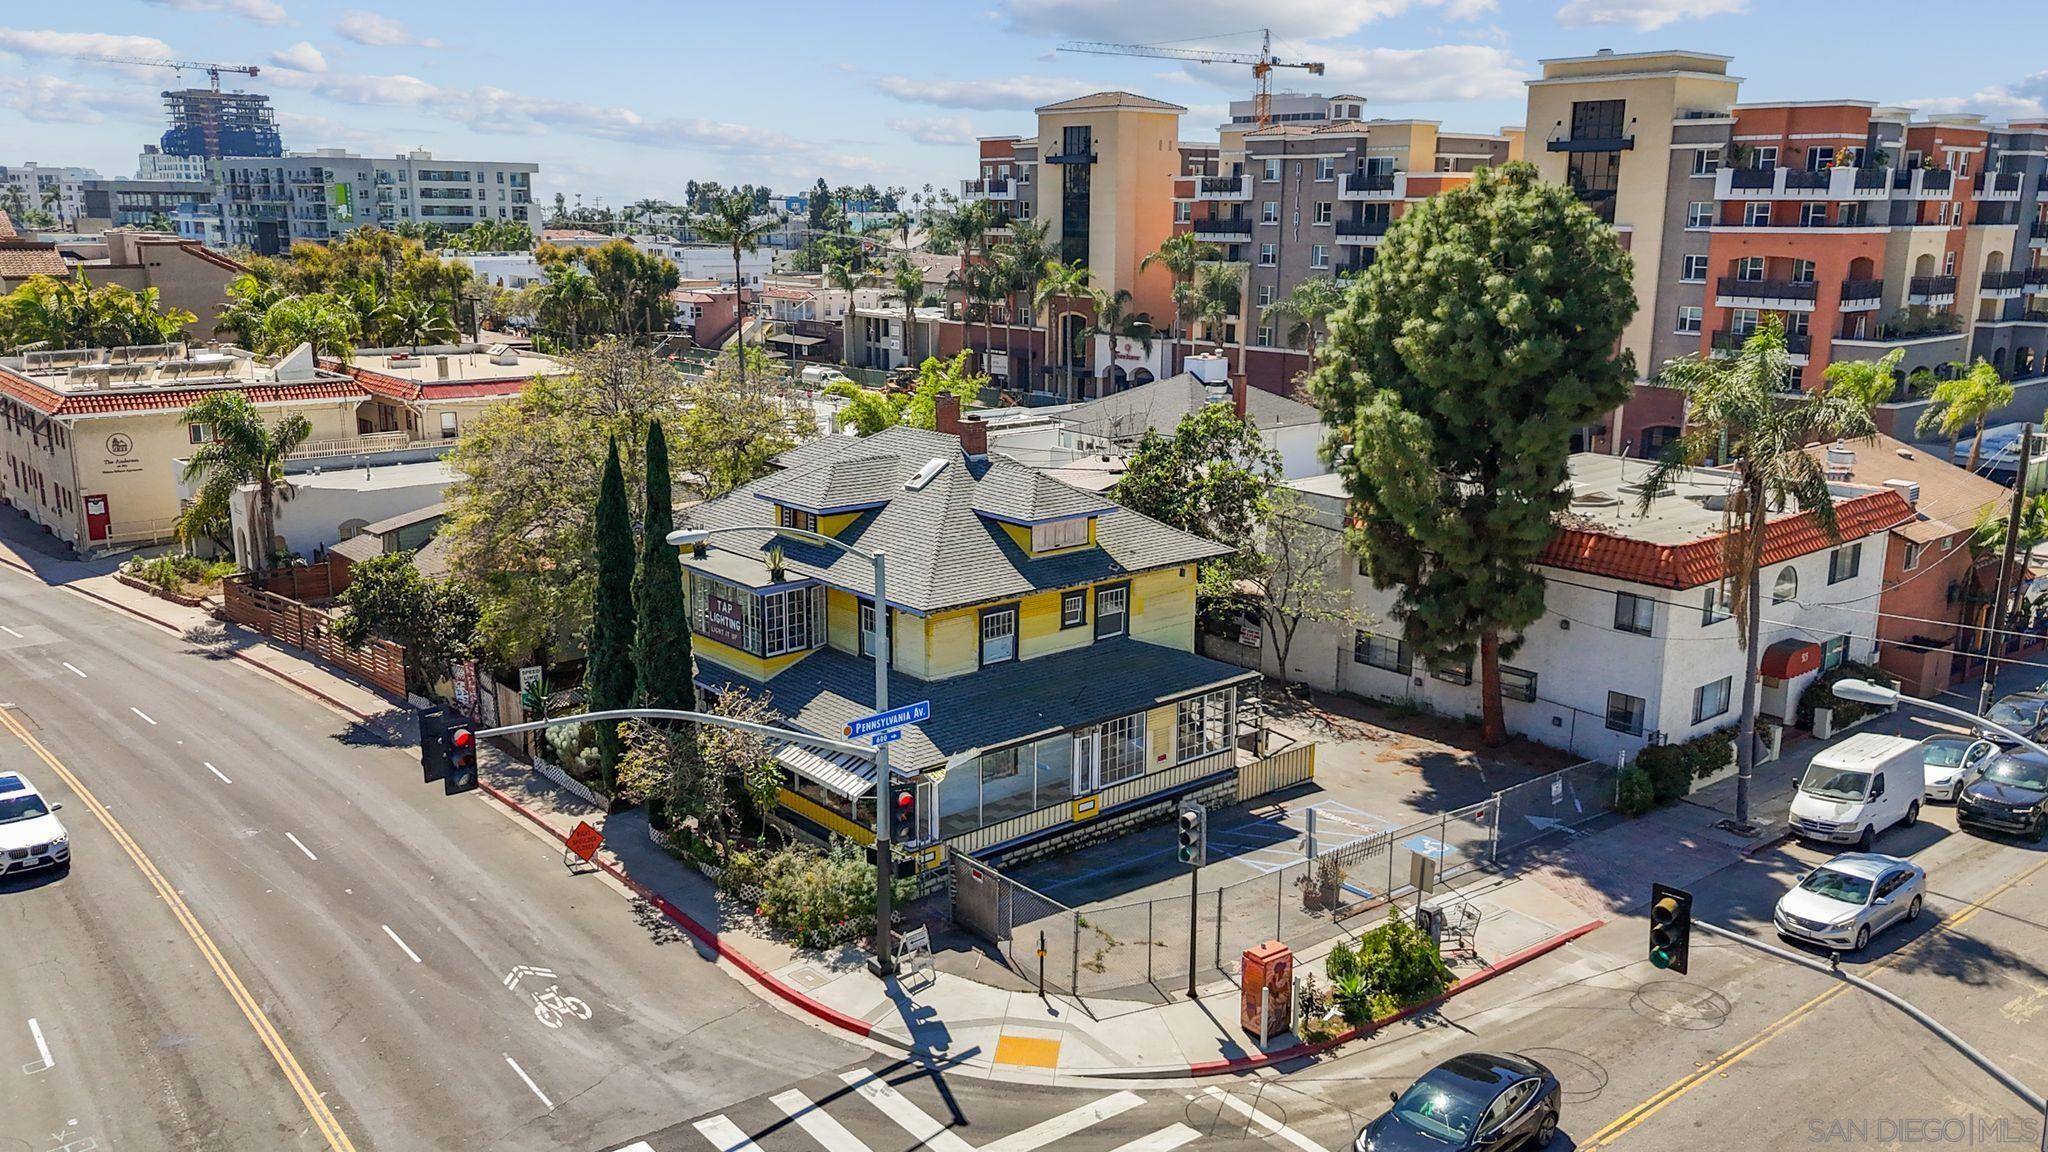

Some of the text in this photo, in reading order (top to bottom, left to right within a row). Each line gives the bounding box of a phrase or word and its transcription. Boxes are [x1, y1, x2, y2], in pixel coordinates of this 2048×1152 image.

[1294, 161, 1302, 242] ATLAS
[717, 600, 733, 613] TAP
[709, 611, 741, 631] LIGHTING
[710, 625, 724, 636] LIGHT
[856, 711, 911, 734] PENNSYLVANIA
[876, 735, 888, 743] 600
